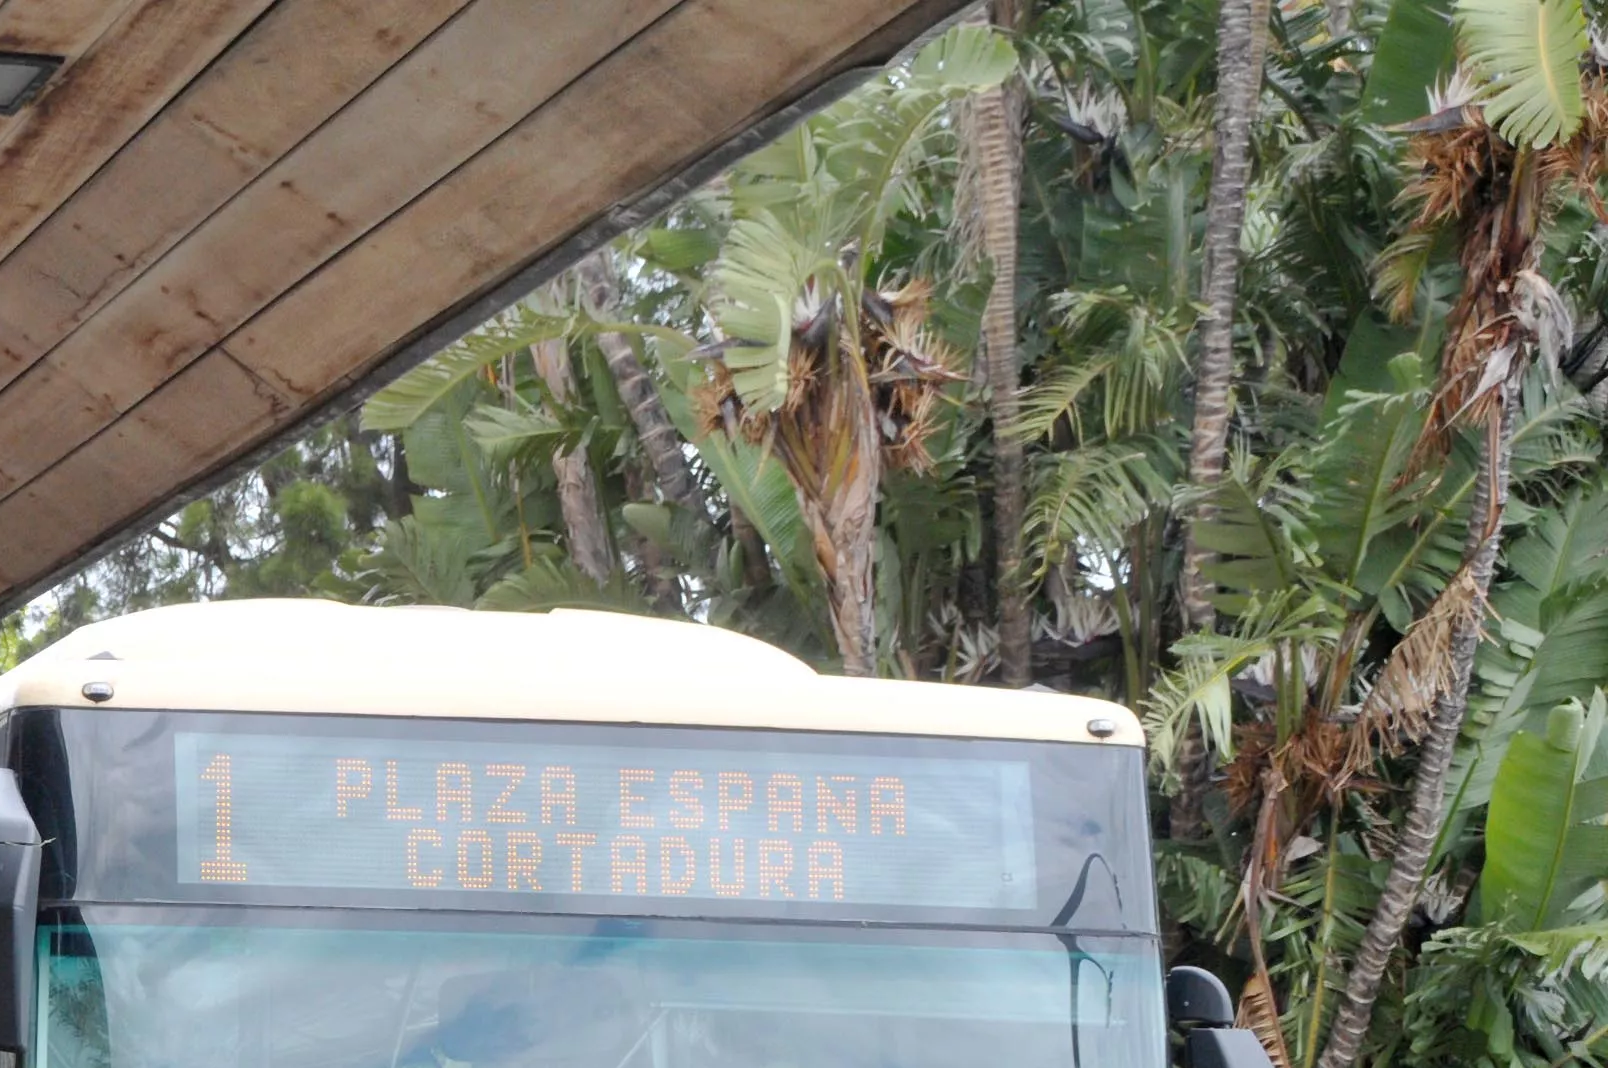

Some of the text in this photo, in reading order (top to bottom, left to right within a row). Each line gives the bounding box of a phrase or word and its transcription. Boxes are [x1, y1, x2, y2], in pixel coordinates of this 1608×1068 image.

[199, 753, 248, 883] 1
[336, 757, 907, 836] PLAZA ESPAÑA
[406, 828, 844, 900] CORTADURA
